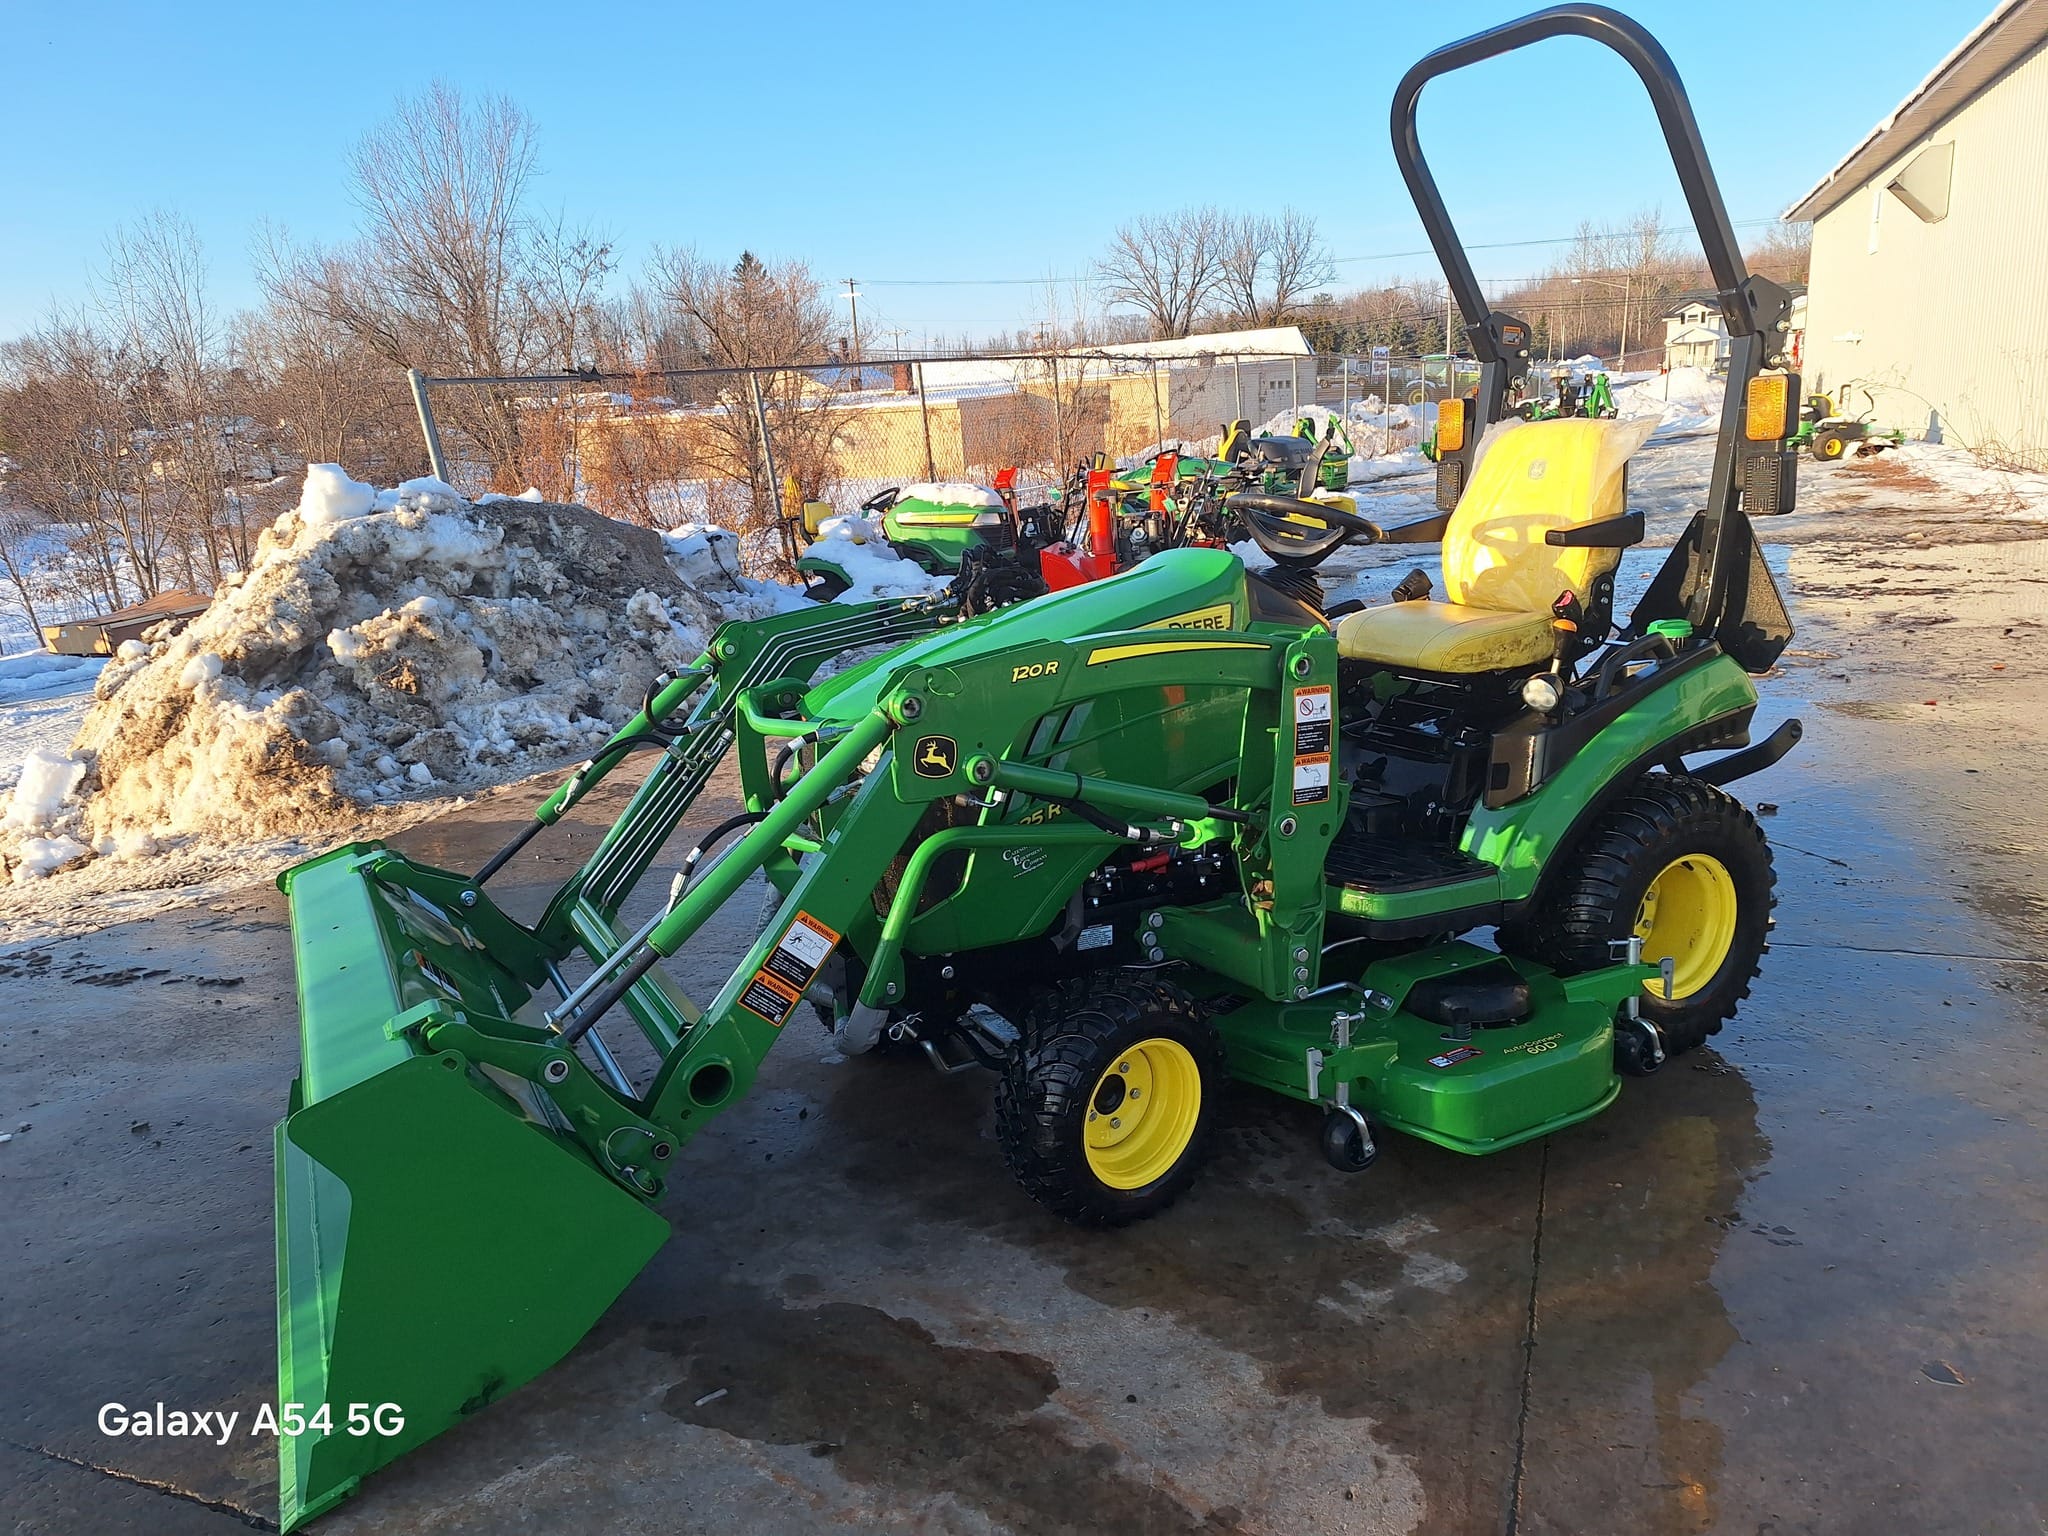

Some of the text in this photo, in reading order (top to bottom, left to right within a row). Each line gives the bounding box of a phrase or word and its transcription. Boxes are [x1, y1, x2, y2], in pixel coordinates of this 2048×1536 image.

[1011, 660, 1060, 683] 120 R
[1302, 687, 1329, 695] WARNING
[1301, 756, 1329, 765] WARNING
[808, 918, 834, 940] WARNING
[766, 979, 794, 1000] WARNING
[1503, 1033, 1564, 1054] AutoConnect
[1527, 1041, 1557, 1054] 60D
